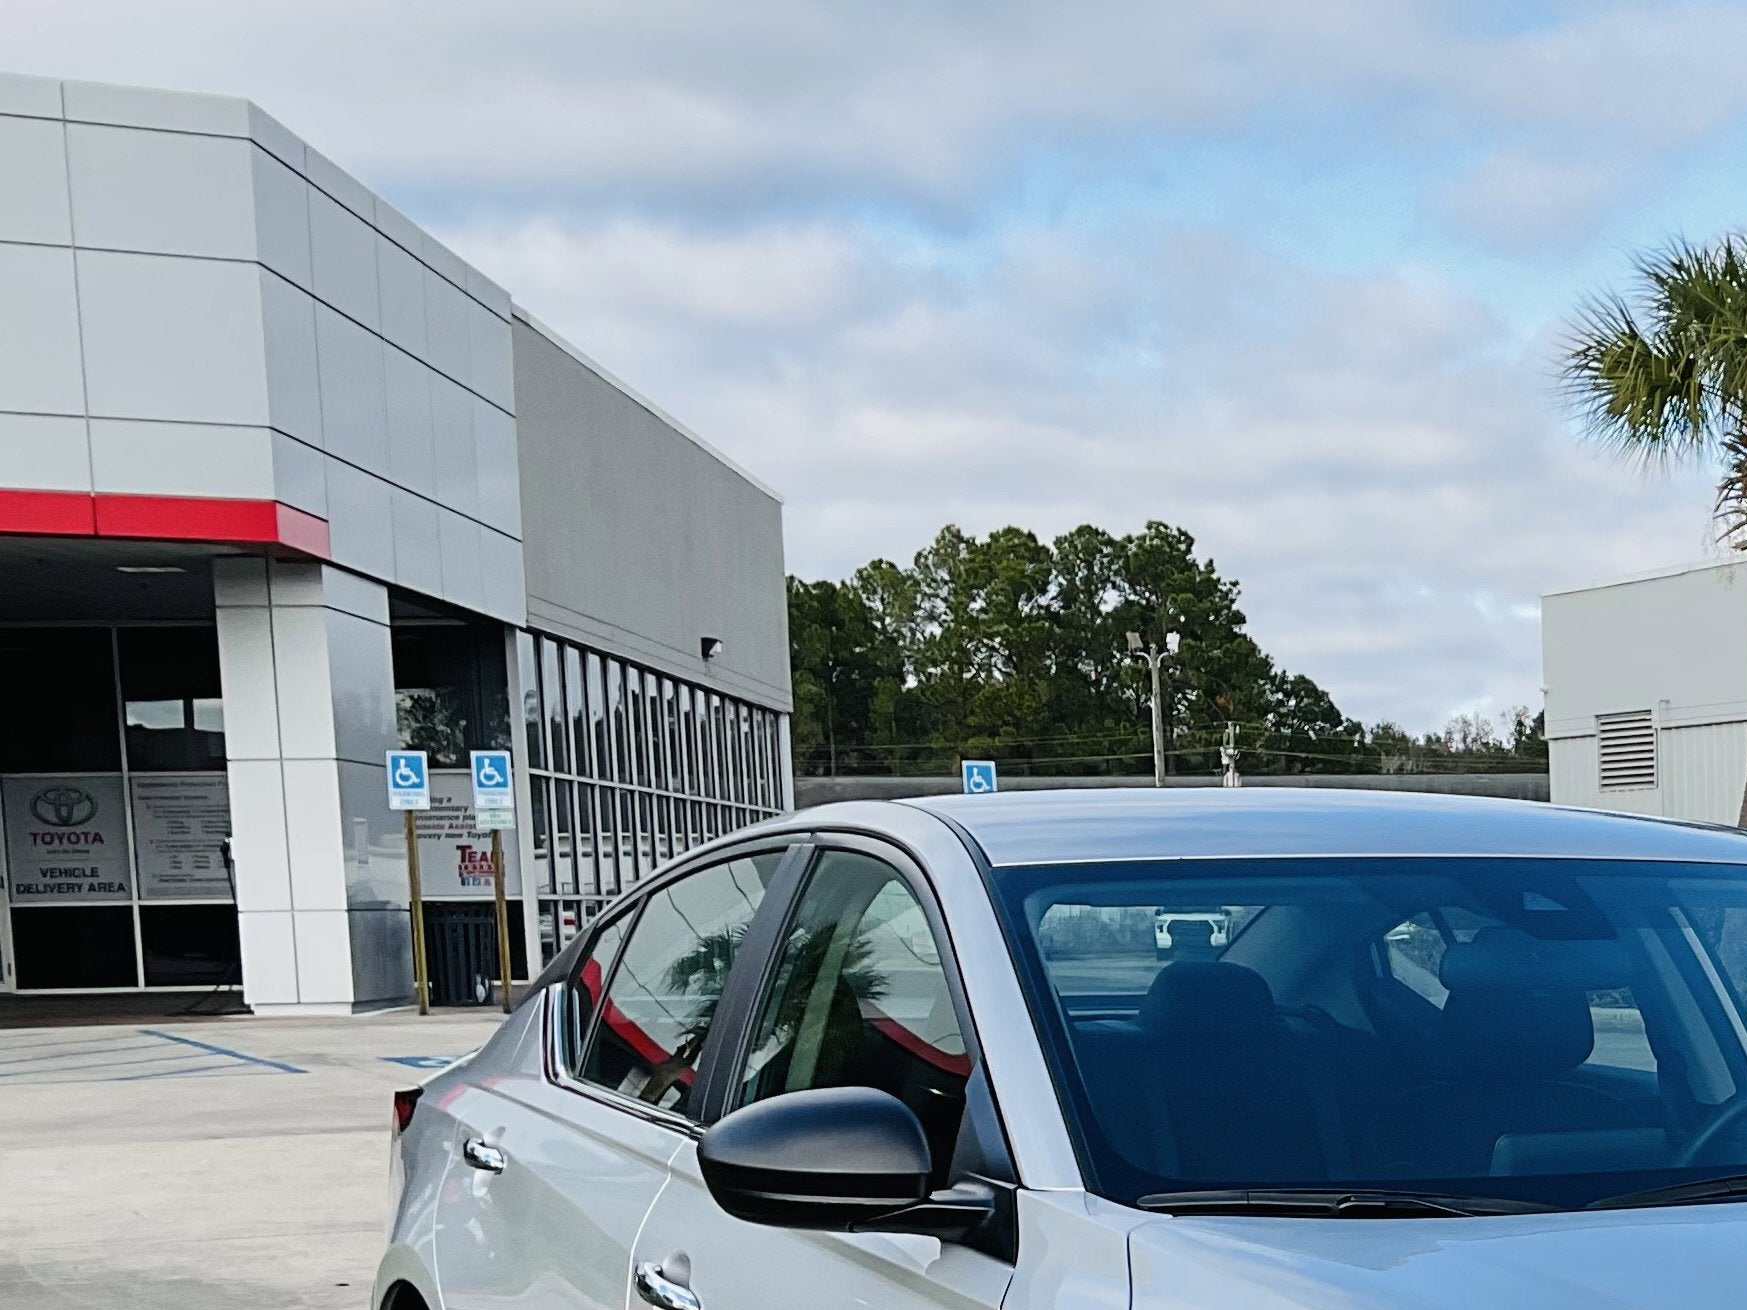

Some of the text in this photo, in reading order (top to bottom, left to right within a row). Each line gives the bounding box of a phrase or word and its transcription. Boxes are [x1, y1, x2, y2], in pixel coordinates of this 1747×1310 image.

[29, 831, 104, 846] TOYOTA
[40, 867, 100, 879] VEHICLE
[16, 882, 126, 895] DELIVERY AREA
